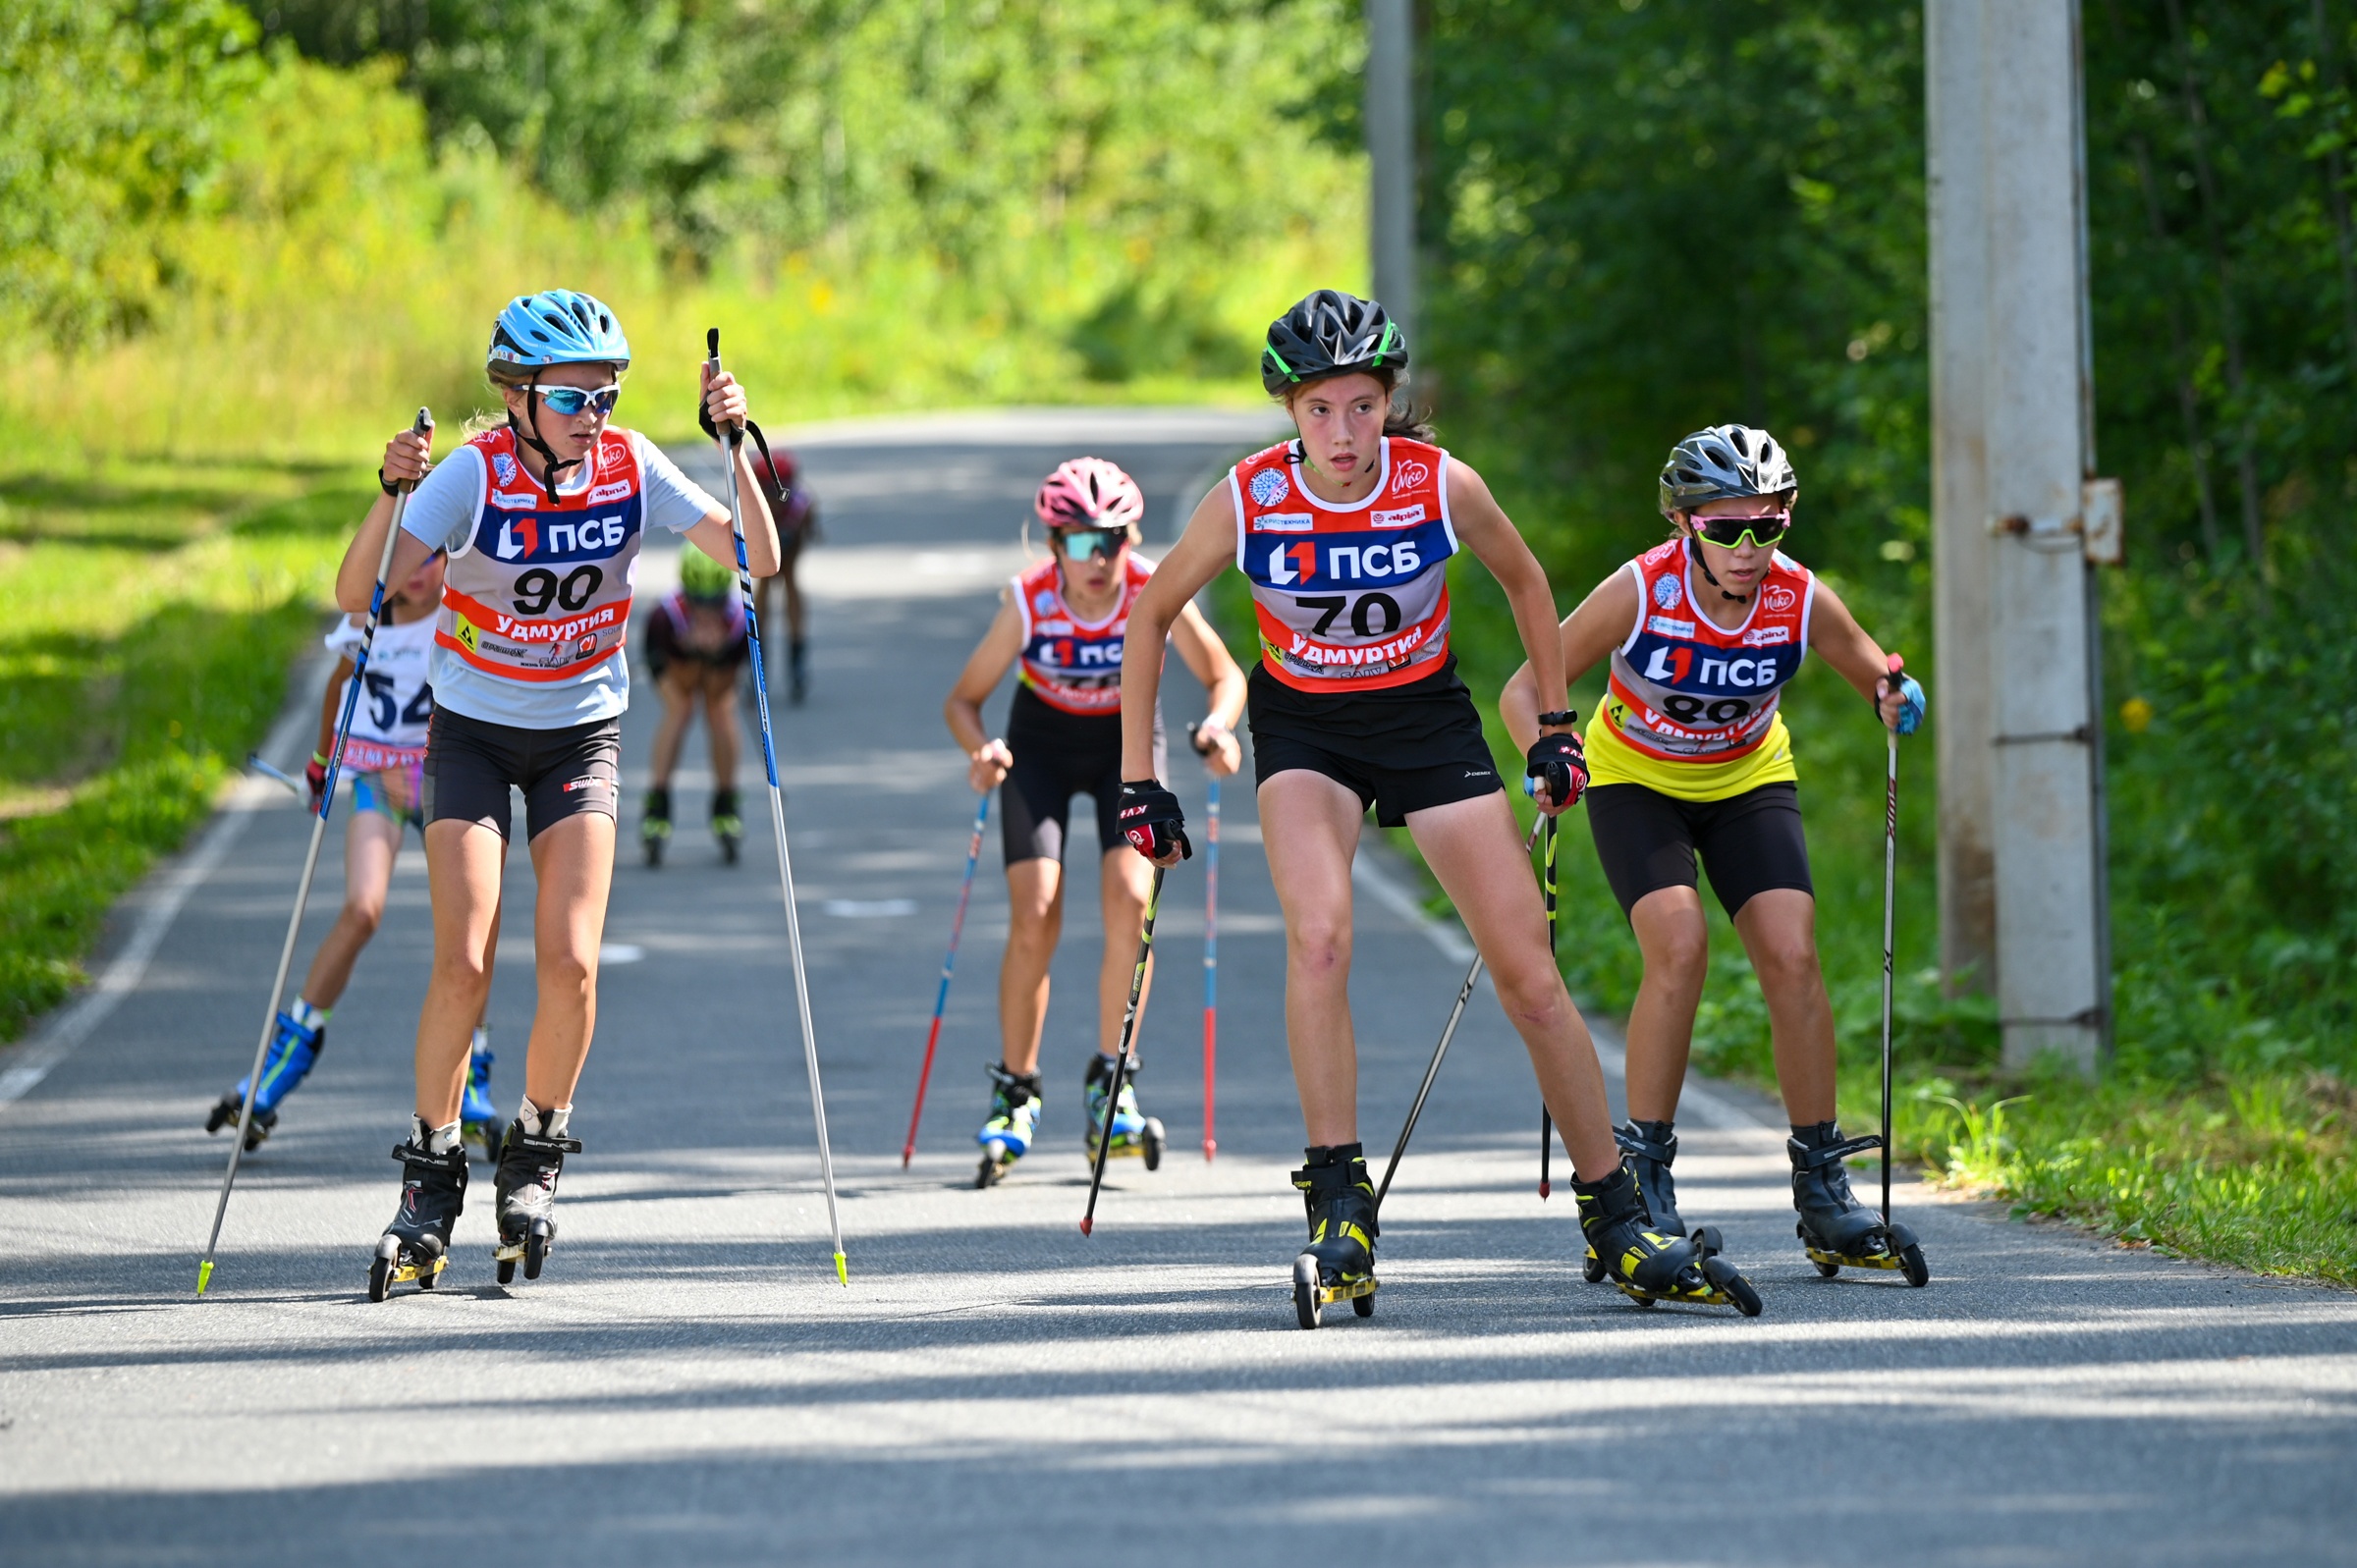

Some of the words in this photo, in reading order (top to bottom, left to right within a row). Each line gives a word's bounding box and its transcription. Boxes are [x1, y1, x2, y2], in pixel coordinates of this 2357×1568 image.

[1388, 511, 1419, 521] alpia
[548, 515, 626, 553] ПСБ
[1329, 541, 1421, 580] ПСБ
[513, 565, 603, 615] 90
[496, 608, 614, 641] Удмуртия
[1295, 592, 1401, 637] 70
[1079, 643, 1123, 666] ПС
[1289, 626, 1422, 665] Удмуртия
[1699, 658, 1778, 687] ПСБ
[1120, 804, 1148, 820] KV+
